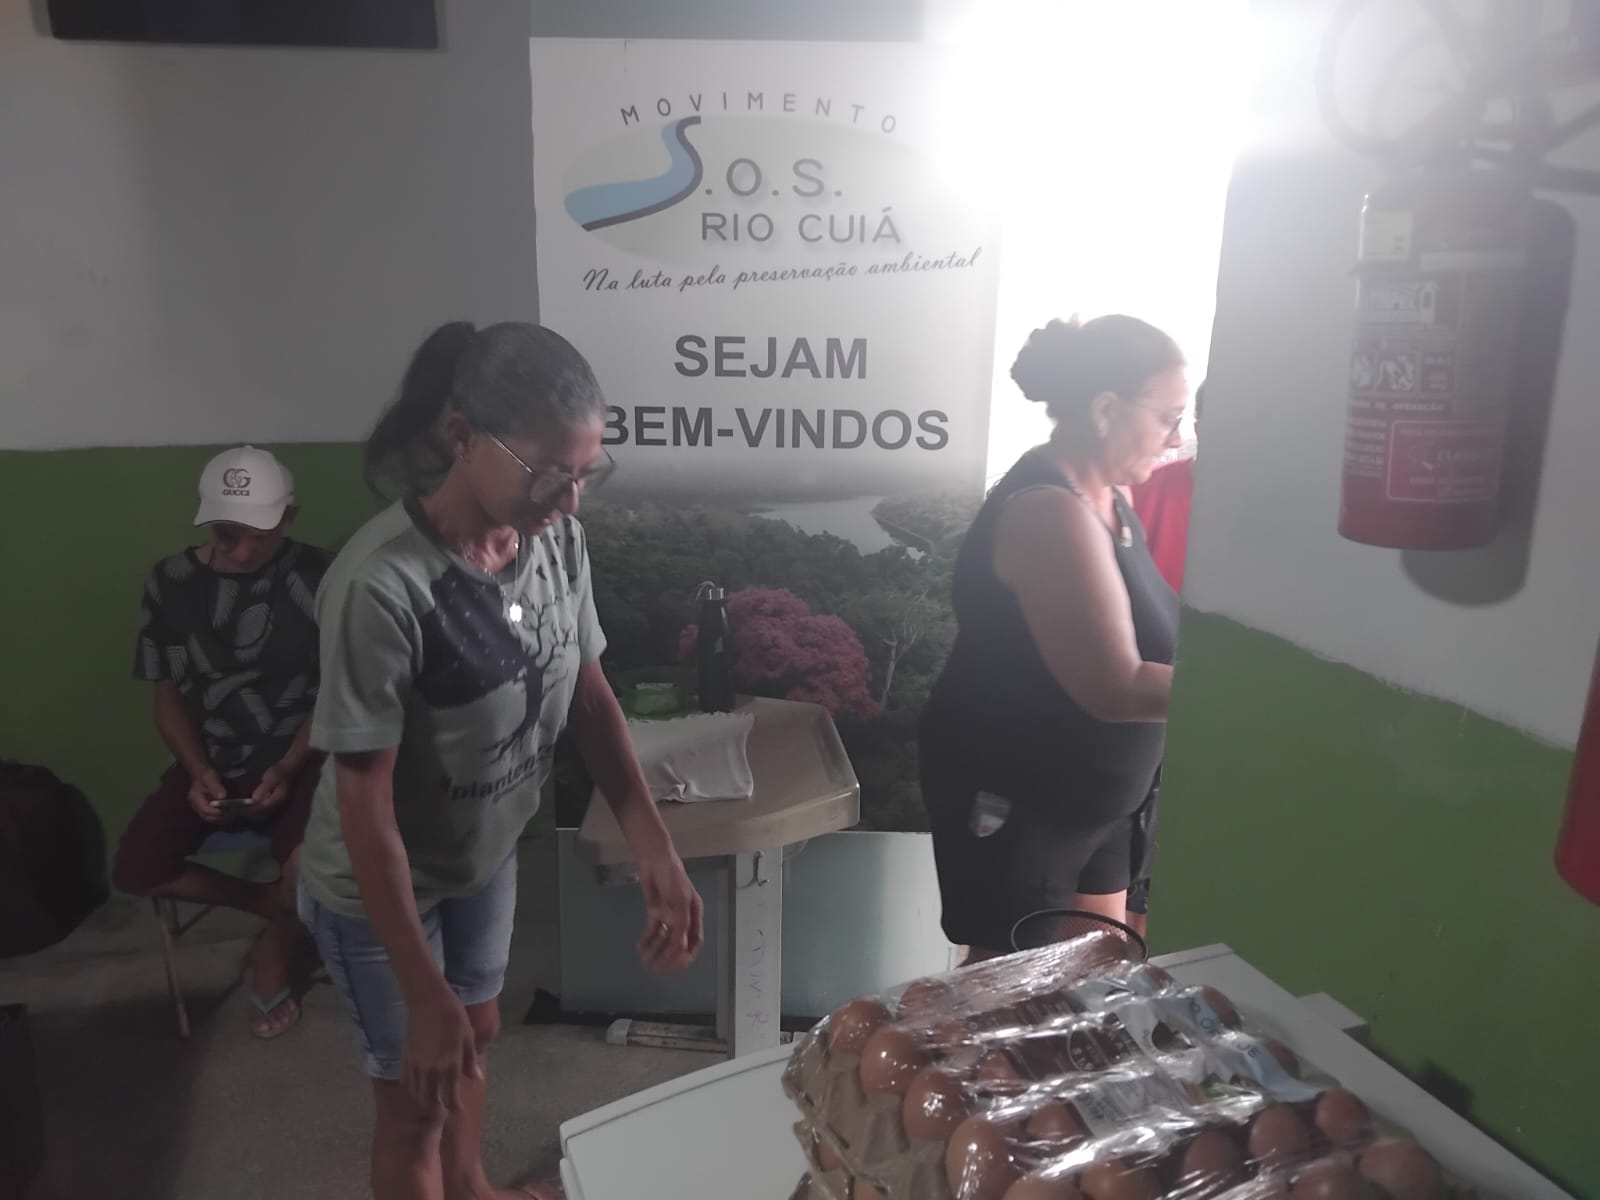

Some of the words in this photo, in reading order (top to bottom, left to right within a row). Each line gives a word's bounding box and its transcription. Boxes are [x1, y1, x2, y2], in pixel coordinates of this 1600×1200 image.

[620, 91, 898, 134] MOVIMENTO
[700, 212, 775, 243] RIO
[798, 206, 903, 244] CUIÁ
[583, 268, 620, 291] Na
[625, 268, 673, 290] luta
[679, 264, 727, 292] pela
[733, 261, 859, 291] preservação
[863, 246, 984, 274] ambiental
[674, 334, 868, 380] SEJAM
[602, 404, 950, 451] BEM-VINDOS
[222, 489, 250, 497] GUCCI
